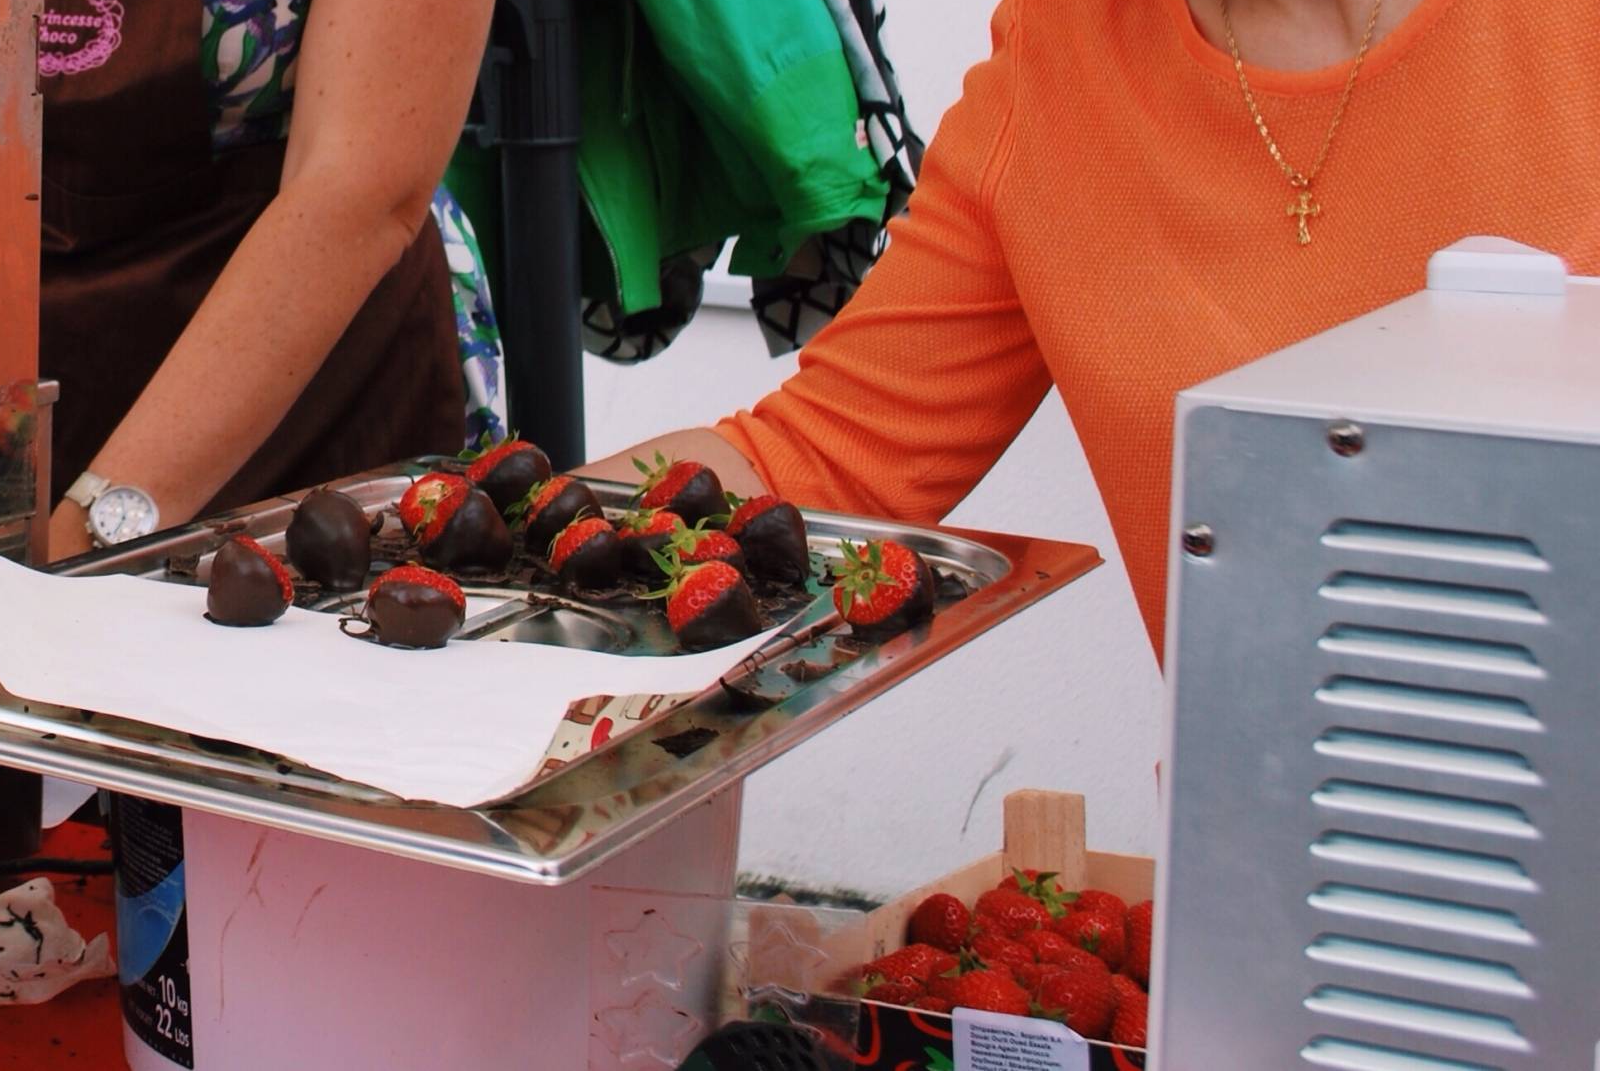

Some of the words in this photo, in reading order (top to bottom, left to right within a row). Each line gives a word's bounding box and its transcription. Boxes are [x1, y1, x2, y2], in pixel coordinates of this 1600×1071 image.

[41, 9, 102, 28] rincesse
[39, 25, 77, 44] hoco
[158, 975, 176, 1008] 10
[177, 996, 188, 1016] kg
[156, 1004, 172, 1039] 22
